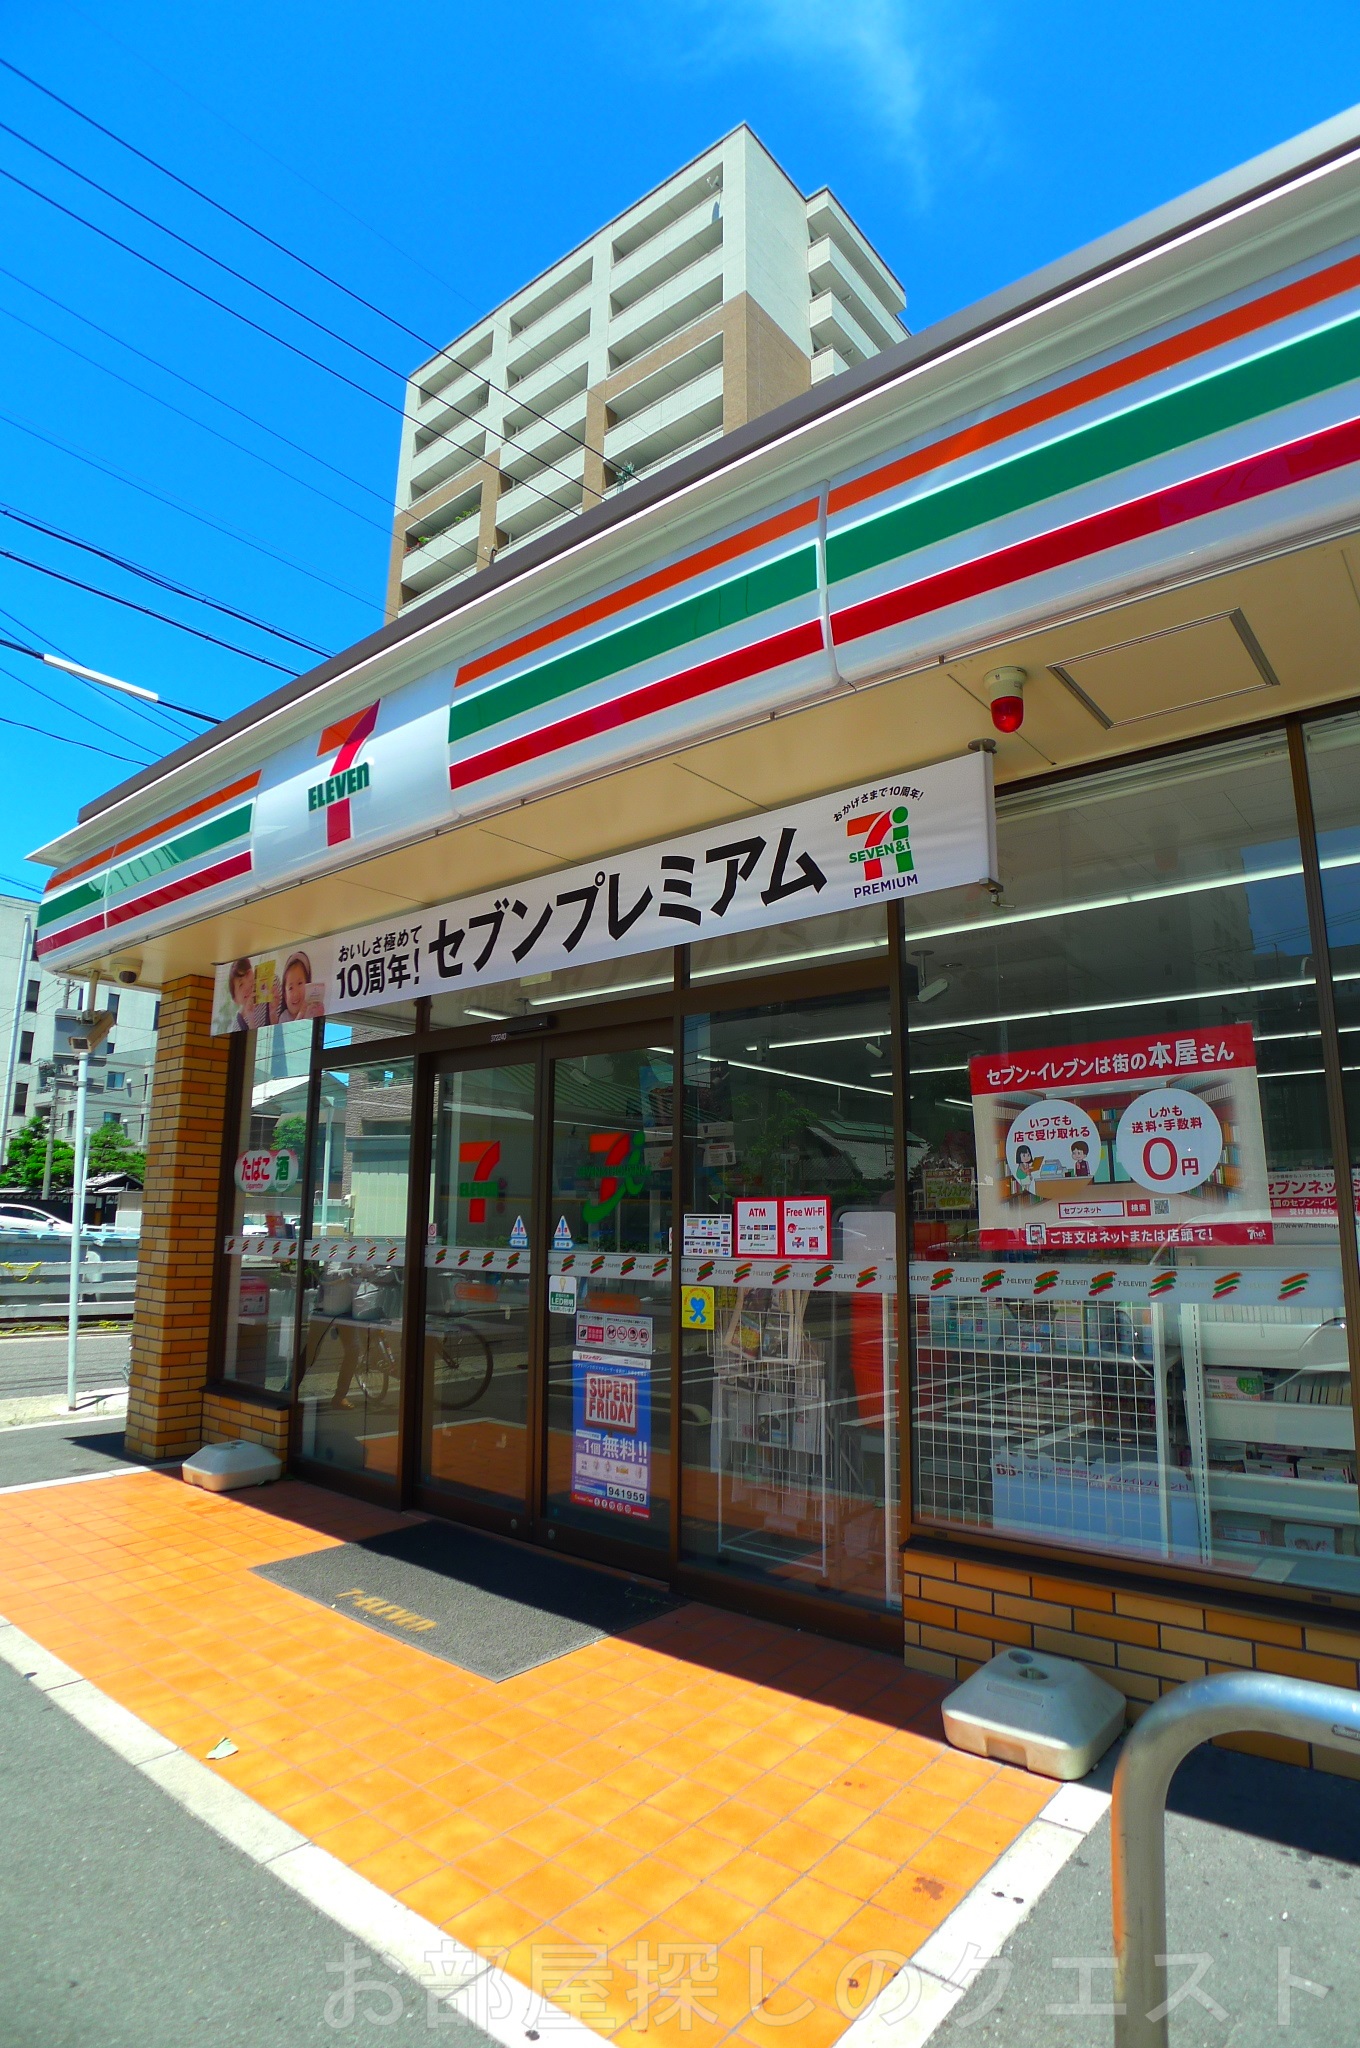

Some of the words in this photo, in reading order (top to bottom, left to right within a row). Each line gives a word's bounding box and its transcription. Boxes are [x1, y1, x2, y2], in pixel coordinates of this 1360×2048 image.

[853, 873, 918, 898] PREMIUM
[428, 827, 828, 979] セブンプレミアム
[338, 925, 423, 963] おいしさ極めて
[337, 947, 420, 999] 10周年!
[1149, 1105, 1183, 1119] しかも
[1029, 1115, 1072, 1128] いつでも
[1013, 1126, 1091, 1143] 店で受け取れる
[241, 1155, 270, 1182] たばこ
[275, 1155, 290, 1181] 酒
[748, 1208, 766, 1217] ATM
[786, 1208, 802, 1217] Free
[804, 1206, 825, 1217] Wi-Fi
[1063, 1206, 1101, 1215] セブンネット
[1050, 1228, 1213, 1245] ご注文はネットまたは店頭で!
[588, 1397, 633, 1424] FRIDAY
[608, 1486, 645, 1503] 941959
